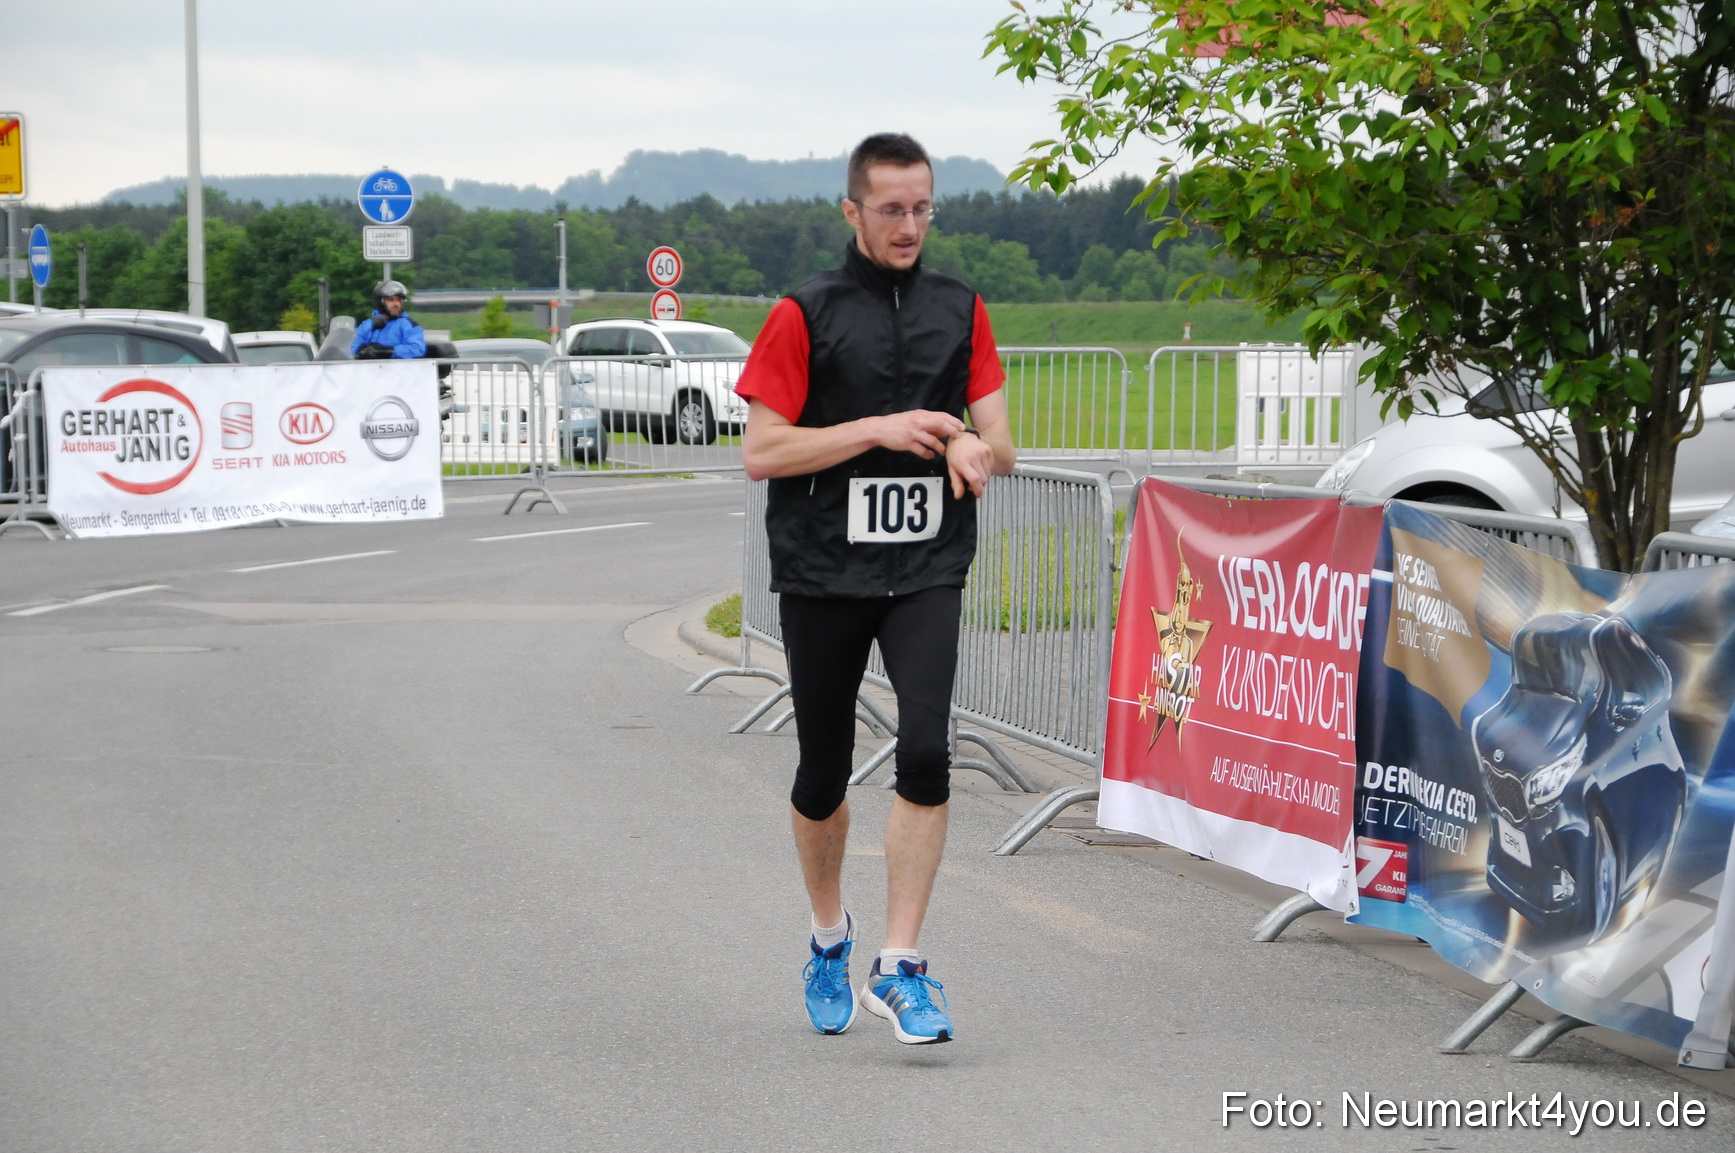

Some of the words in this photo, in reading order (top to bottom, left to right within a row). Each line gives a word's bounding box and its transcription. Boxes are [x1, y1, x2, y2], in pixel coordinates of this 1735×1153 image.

[655, 258, 674, 276] 60
[60, 407, 174, 437] GERHART
[176, 413, 186, 427] &
[288, 412, 325, 436] KIA
[365, 422, 414, 436] NISSAN
[60, 440, 117, 453] Autohaus
[114, 434, 190, 463] JÄNIG
[272, 454, 290, 467] KIA
[294, 450, 347, 466] MOTORS
[212, 457, 264, 471] SEAT
[62, 512, 111, 530] Neumarkt
[121, 510, 182, 529] Sengenthal
[190, 507, 211, 523] Tel.
[298, 494, 427, 518] www.gerhart-jaenig.de
[863, 482, 928, 533] 103
[1210, 756, 1231, 783] AUF
[1363, 761, 1411, 795] DER
[1423, 779, 1445, 812] KIA
[1358, 795, 1413, 829] JETZT
[1356, 844, 1394, 889] 7
